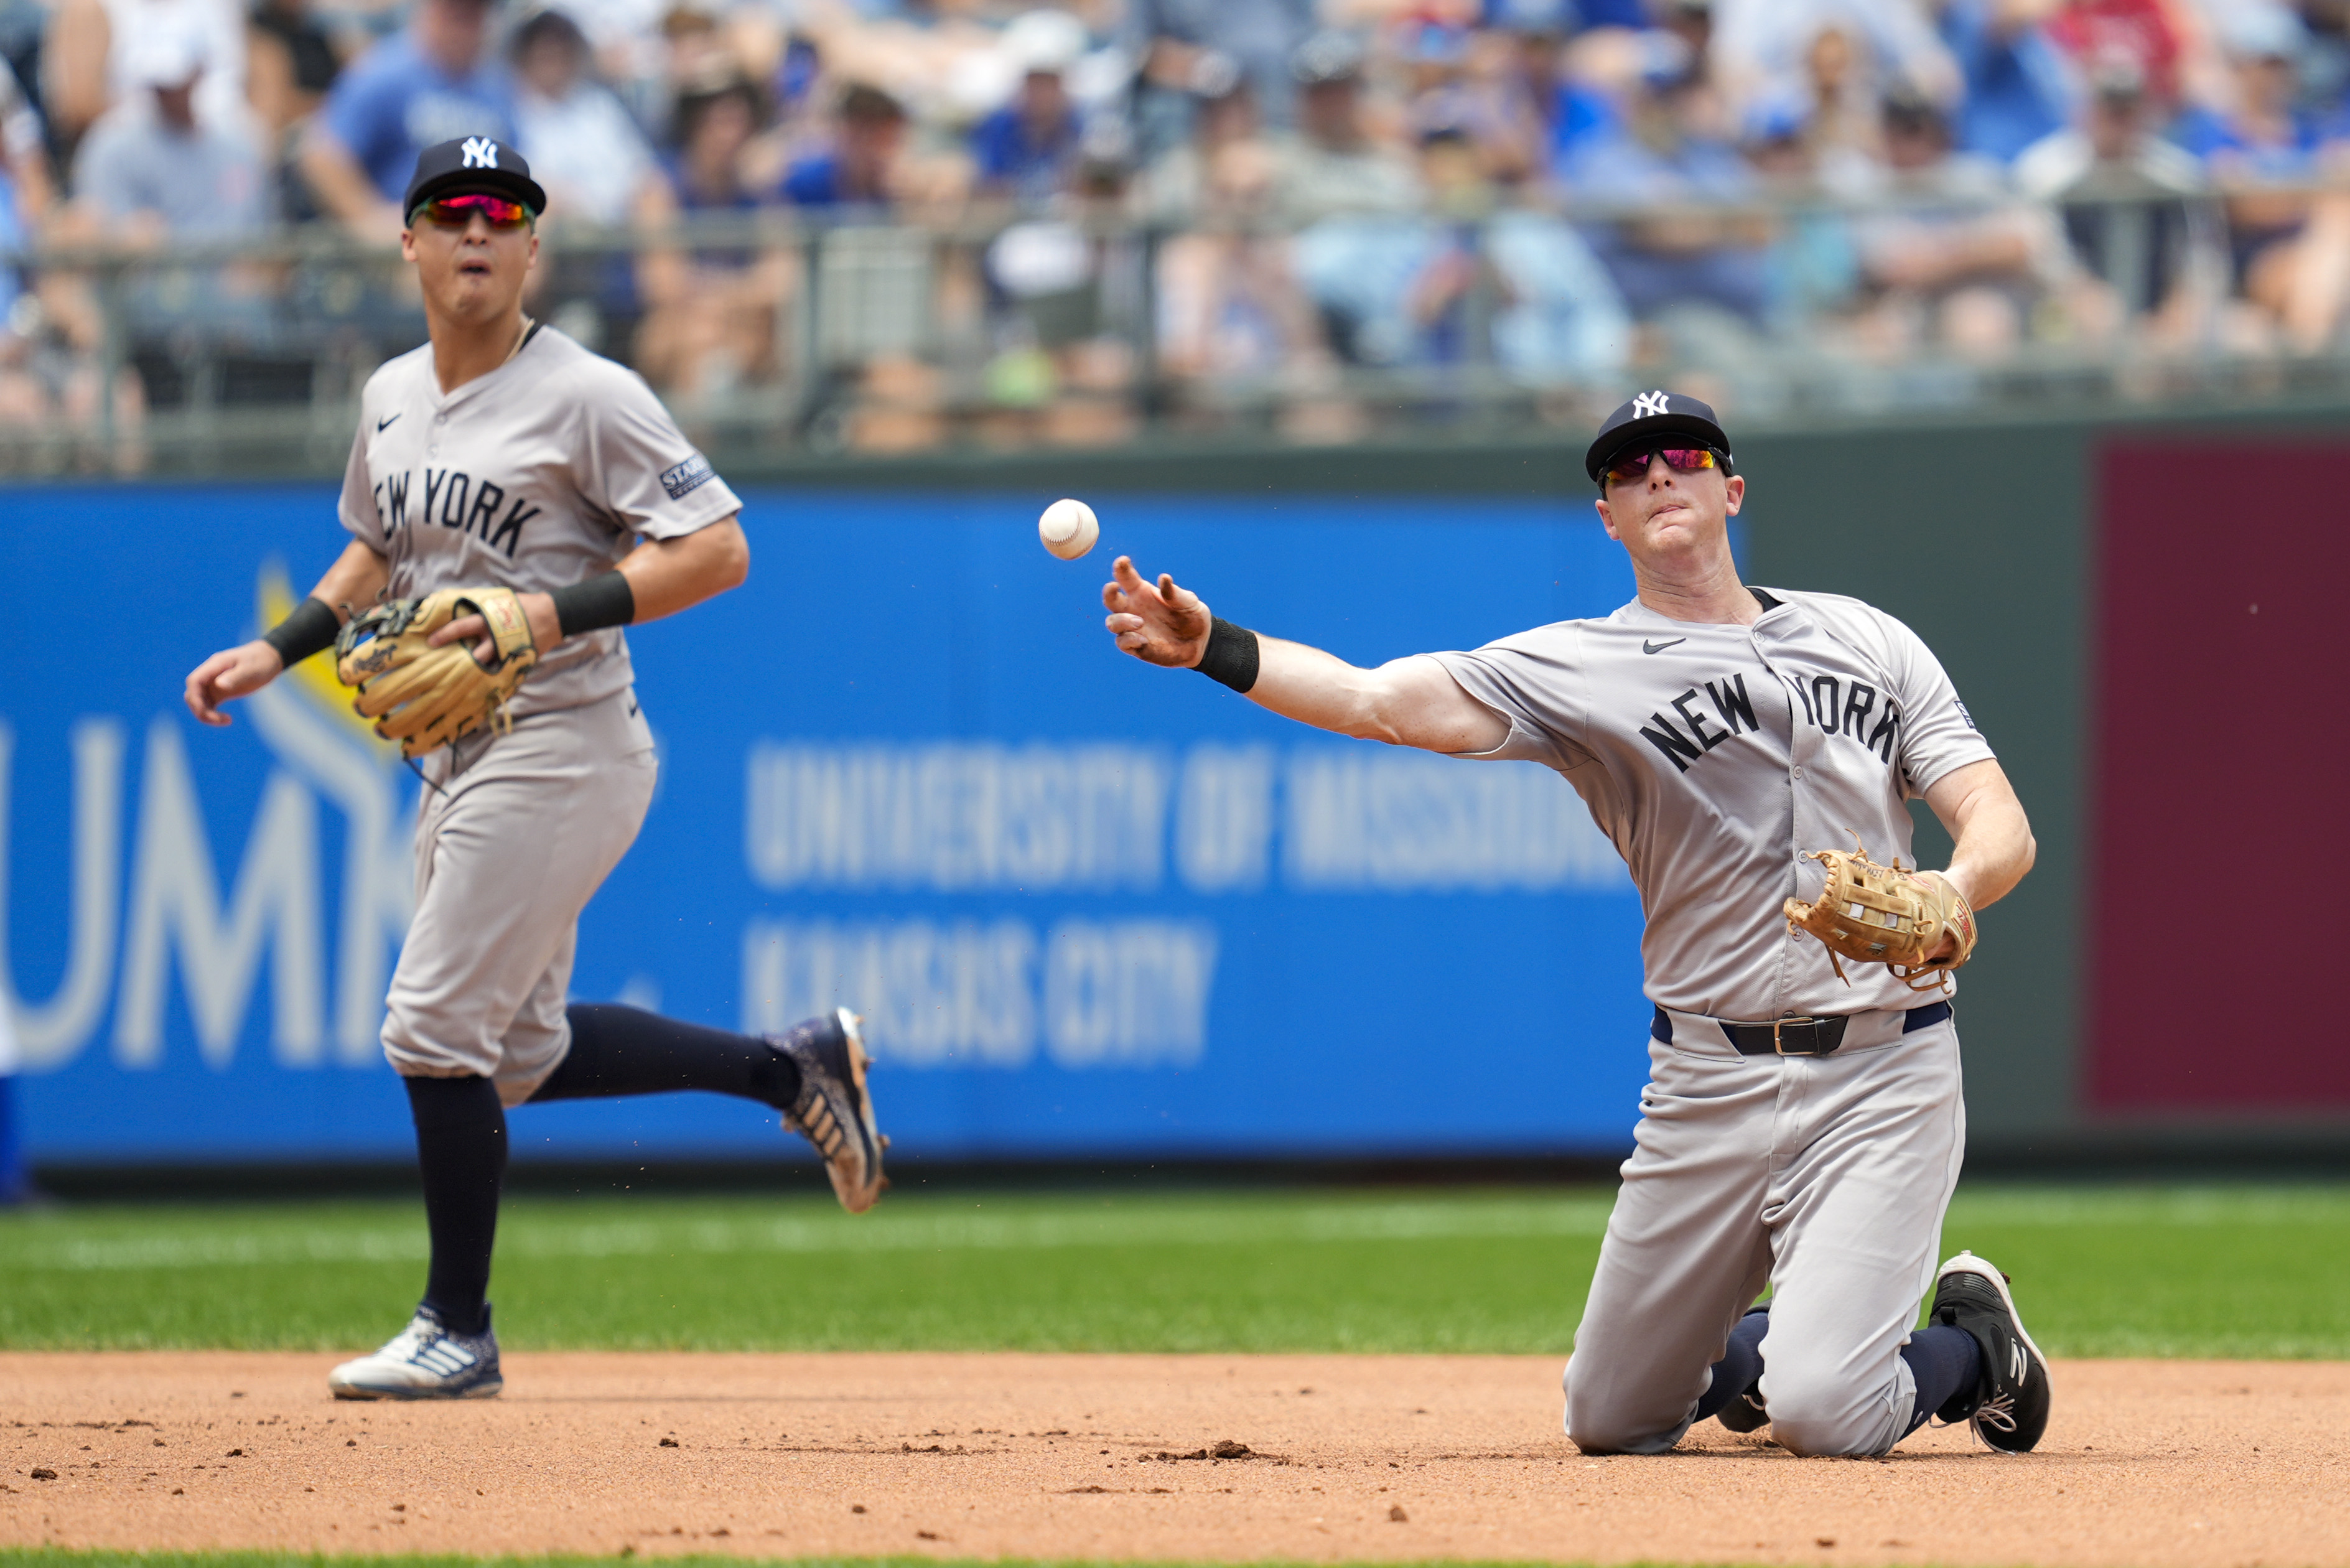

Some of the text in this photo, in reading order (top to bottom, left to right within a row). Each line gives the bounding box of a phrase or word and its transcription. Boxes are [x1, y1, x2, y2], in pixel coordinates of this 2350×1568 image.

[461, 136, 498, 169] NY
[1633, 390, 1669, 419] NY
[375, 469, 541, 558] EW YORK
[1639, 673, 1900, 773] NEW YORK
[1173, 742, 1273, 889] OF
